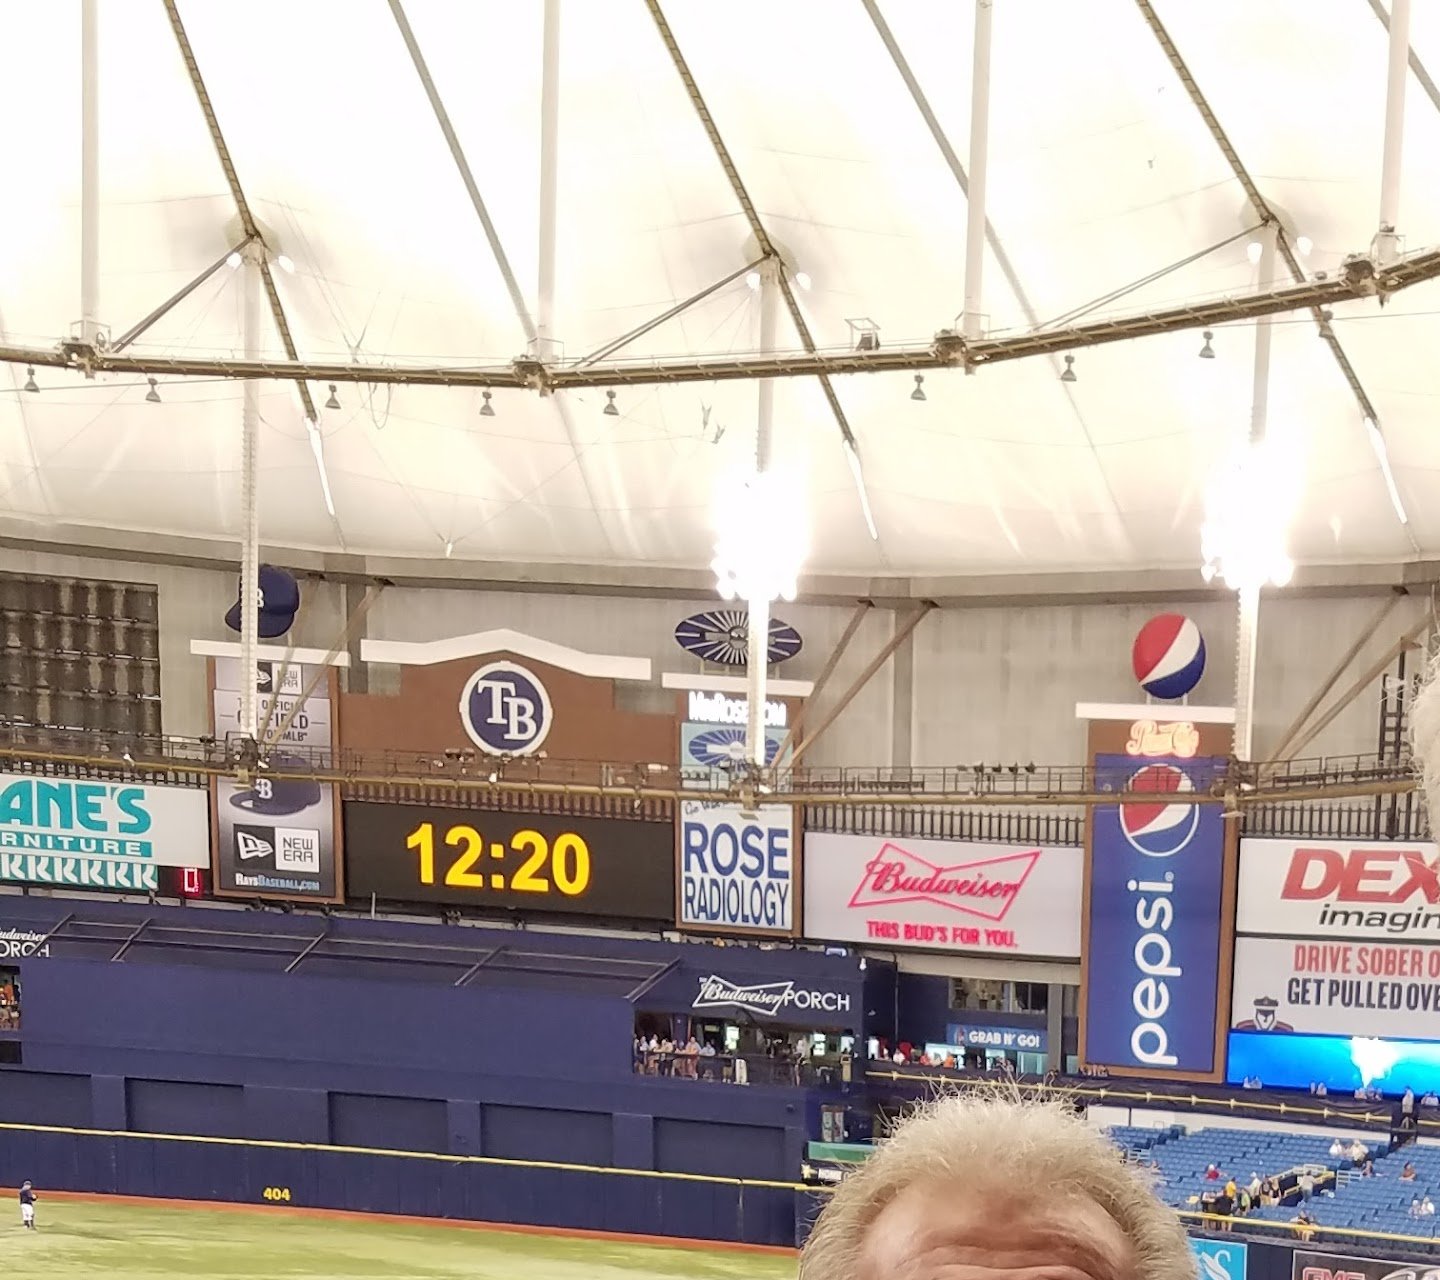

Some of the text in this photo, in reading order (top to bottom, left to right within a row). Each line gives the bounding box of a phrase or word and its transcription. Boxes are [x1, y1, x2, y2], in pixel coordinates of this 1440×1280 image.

[477, 680, 537, 741] TB
[283, 837, 313, 850] NEW
[283, 849, 313, 863] ERA
[407, 823, 590, 895] 12:20
[684, 821, 789, 880] ROSE
[866, 861, 1021, 898] Budweiser
[684, 876, 789, 927] RADIOLOGY
[866, 920, 1019, 949] THIS BUD'S FOR YOU.
[1127, 878, 1183, 1066] pepsi
[1294, 944, 1353, 974] DRIVE
[1356, 946, 1424, 978] SOBER
[700, 982, 784, 1006] Budweiser
[783, 989, 851, 1012] PORCH
[1287, 977, 1326, 1006] GET
[1328, 979, 1403, 1010] PULLED
[969, 1031, 1002, 1045] GRAB
[1017, 1034, 1041, 1048] GO!
[263, 1186, 292, 1202] 404
